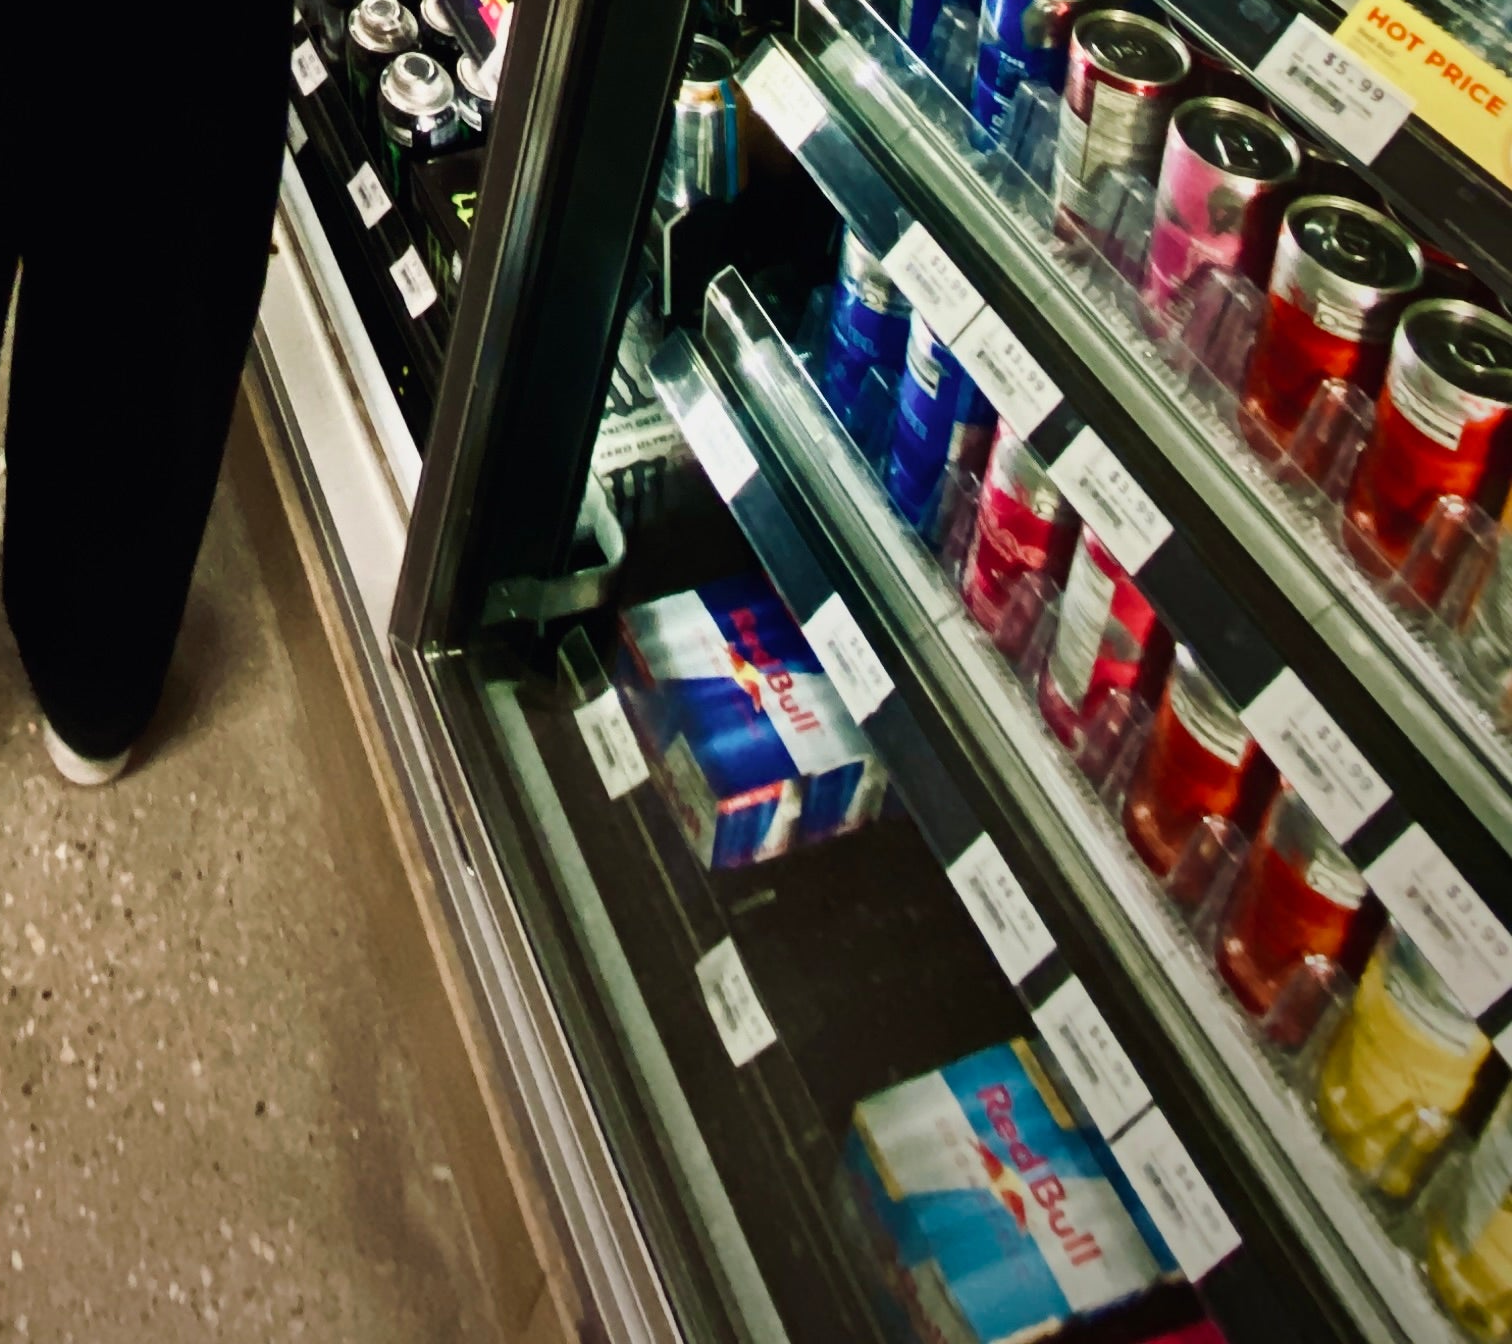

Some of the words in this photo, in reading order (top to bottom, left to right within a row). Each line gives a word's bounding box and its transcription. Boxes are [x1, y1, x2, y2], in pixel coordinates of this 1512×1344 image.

[1322, 51, 1386, 104] $5.99
[1367, 6, 1425, 53] HOT
[1425, 48, 1508, 119] PRICE
[766, 670, 822, 734] Bull
[976, 1083, 1048, 1174] Red
[1029, 1174, 1102, 1267] Bull
